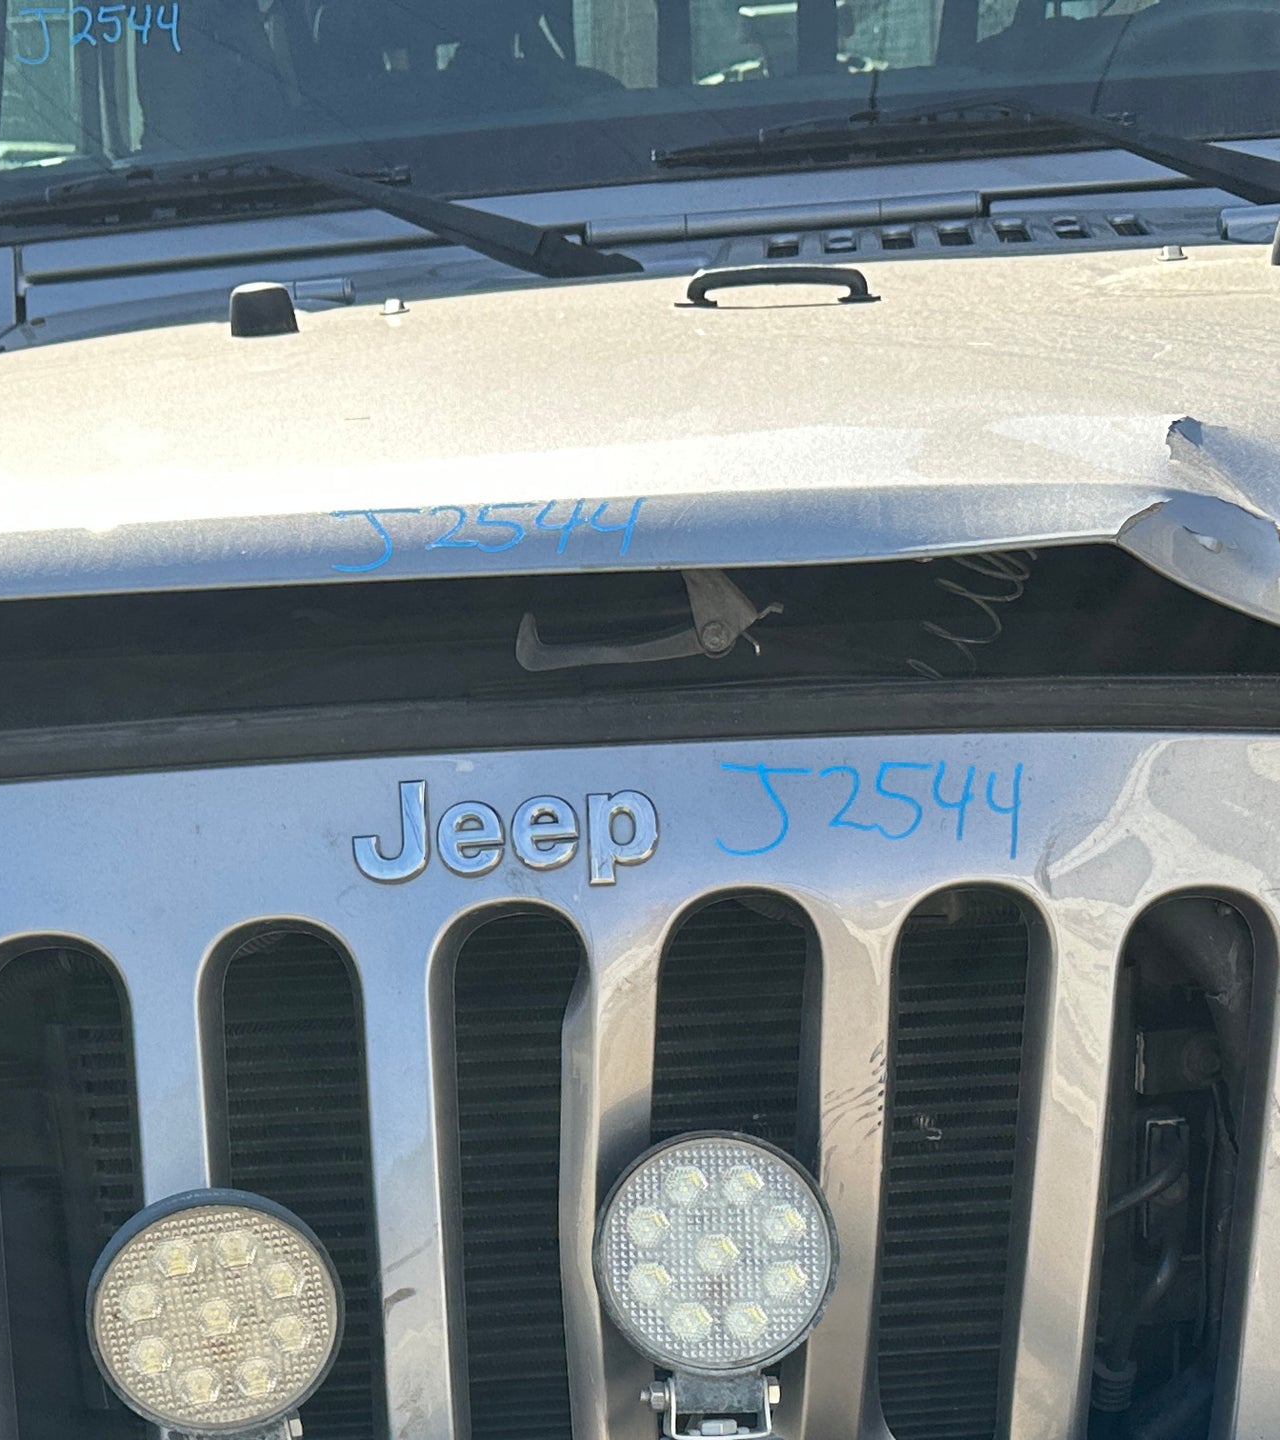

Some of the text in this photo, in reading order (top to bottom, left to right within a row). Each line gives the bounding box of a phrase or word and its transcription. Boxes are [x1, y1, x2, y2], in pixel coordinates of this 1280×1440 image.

[16, 3, 182, 65] J2544
[329, 497, 647, 572] J2544
[352, 778, 660, 886] Jeep
[716, 761, 1024, 860] J2544
